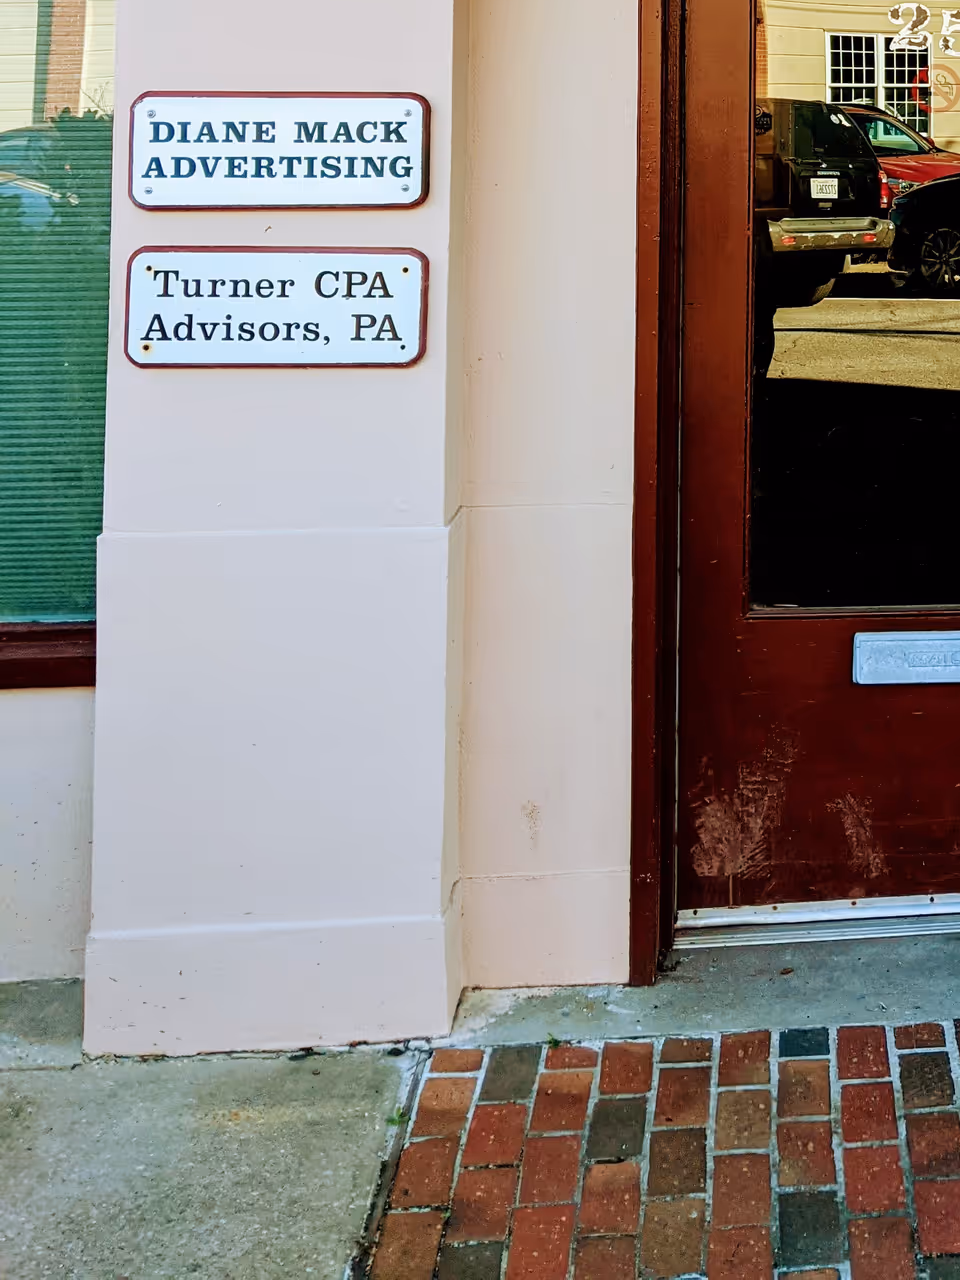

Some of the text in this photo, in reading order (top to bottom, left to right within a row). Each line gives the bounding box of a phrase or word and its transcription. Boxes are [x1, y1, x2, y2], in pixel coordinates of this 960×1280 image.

[148, 121, 408, 144] DIANE MACK
[141, 155, 414, 179] ADVERTISING
[153, 270, 395, 299] Turner CPA
[140, 313, 403, 346] Advisors, PA
